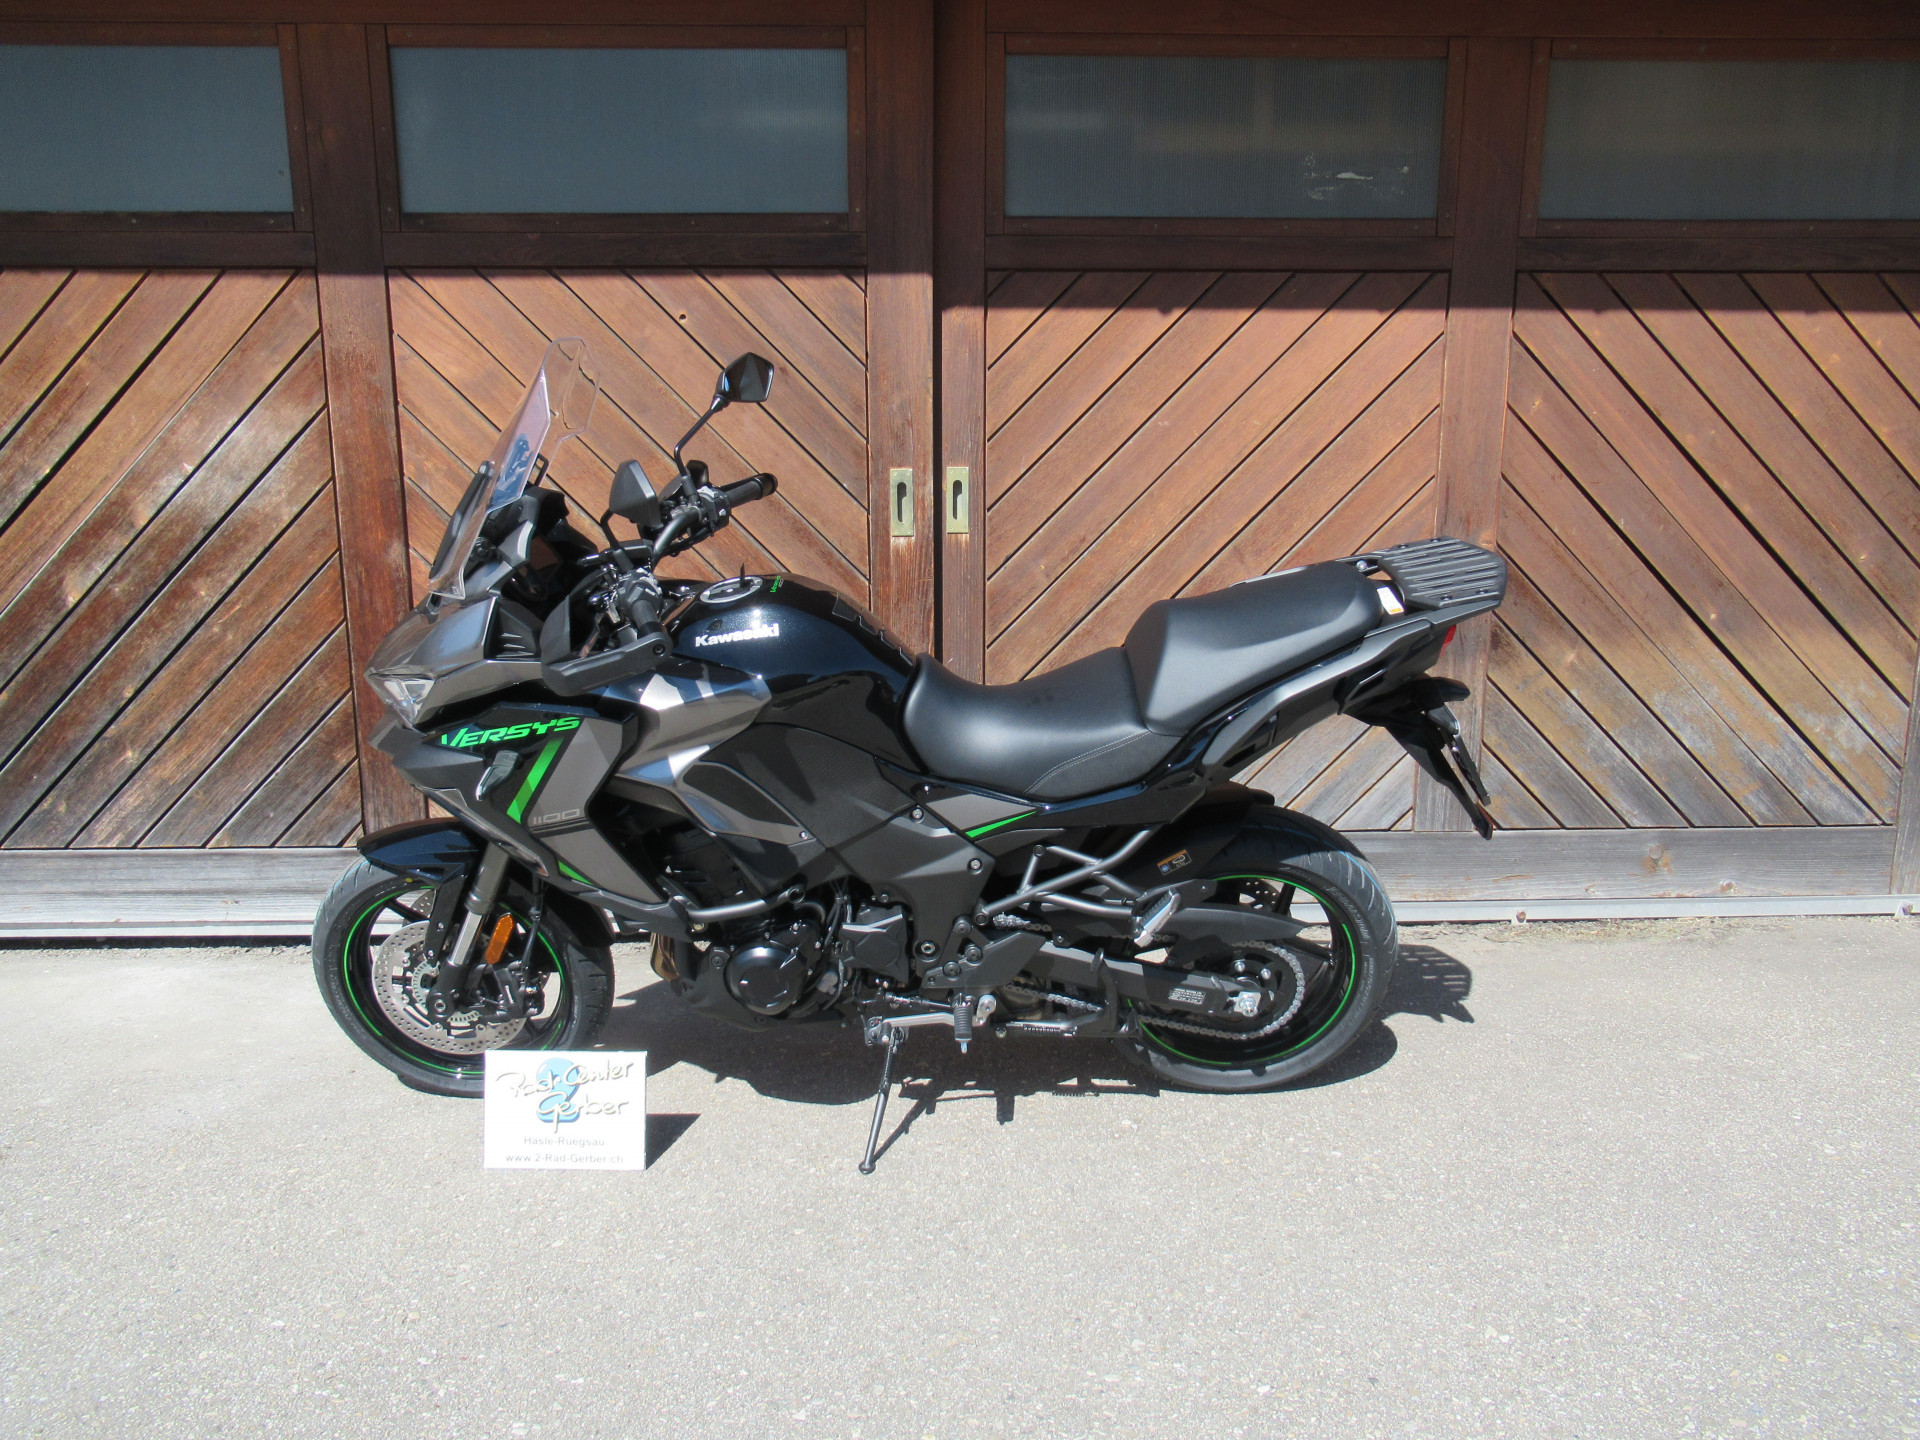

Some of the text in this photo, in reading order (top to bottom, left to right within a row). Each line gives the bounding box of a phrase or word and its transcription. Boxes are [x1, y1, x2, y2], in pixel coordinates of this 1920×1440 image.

[695, 623, 779, 647] Kawasaki
[441, 717, 580, 748] VERSYS
[533, 808, 581, 825] 1100
[537, 1092, 629, 1134] Gerber
